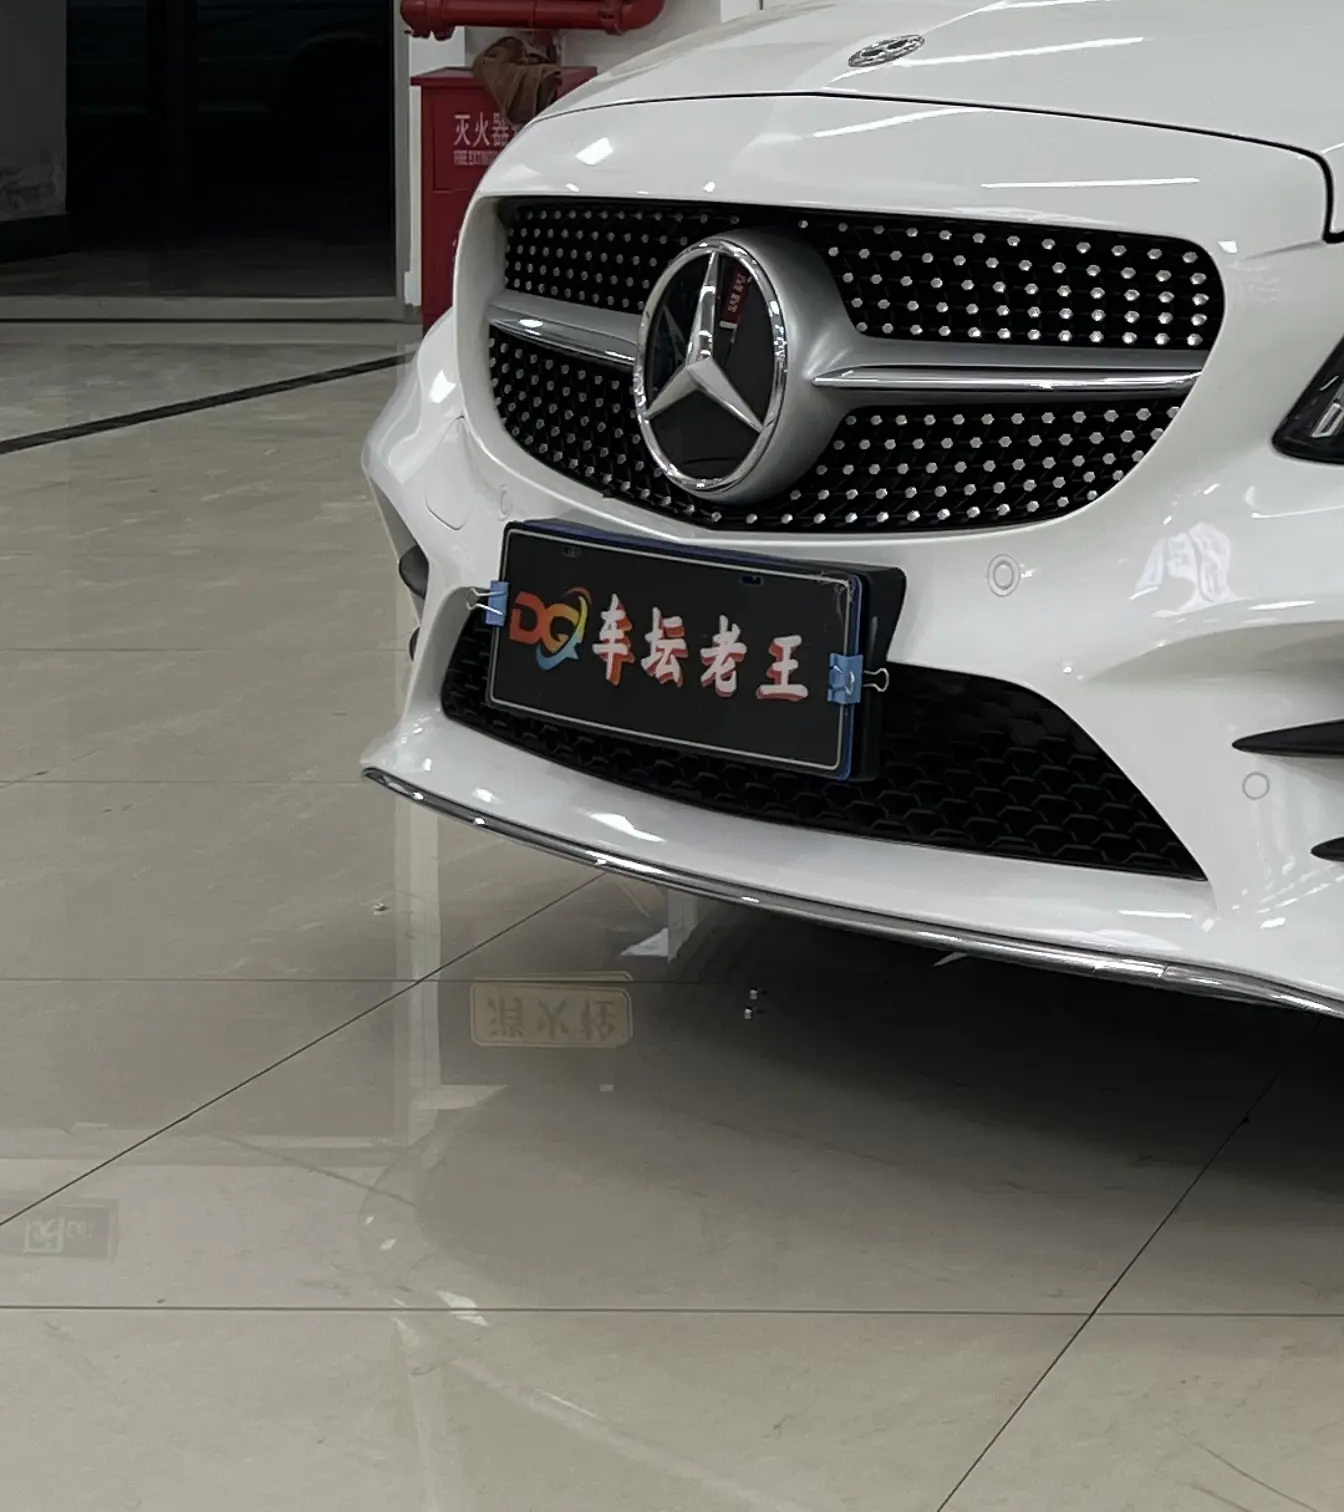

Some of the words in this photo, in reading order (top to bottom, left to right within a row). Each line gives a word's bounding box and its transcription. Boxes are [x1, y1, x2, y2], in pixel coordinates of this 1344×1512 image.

[454, 112, 516, 147] 灭火器
[592, 593, 809, 701] 车坛老王
